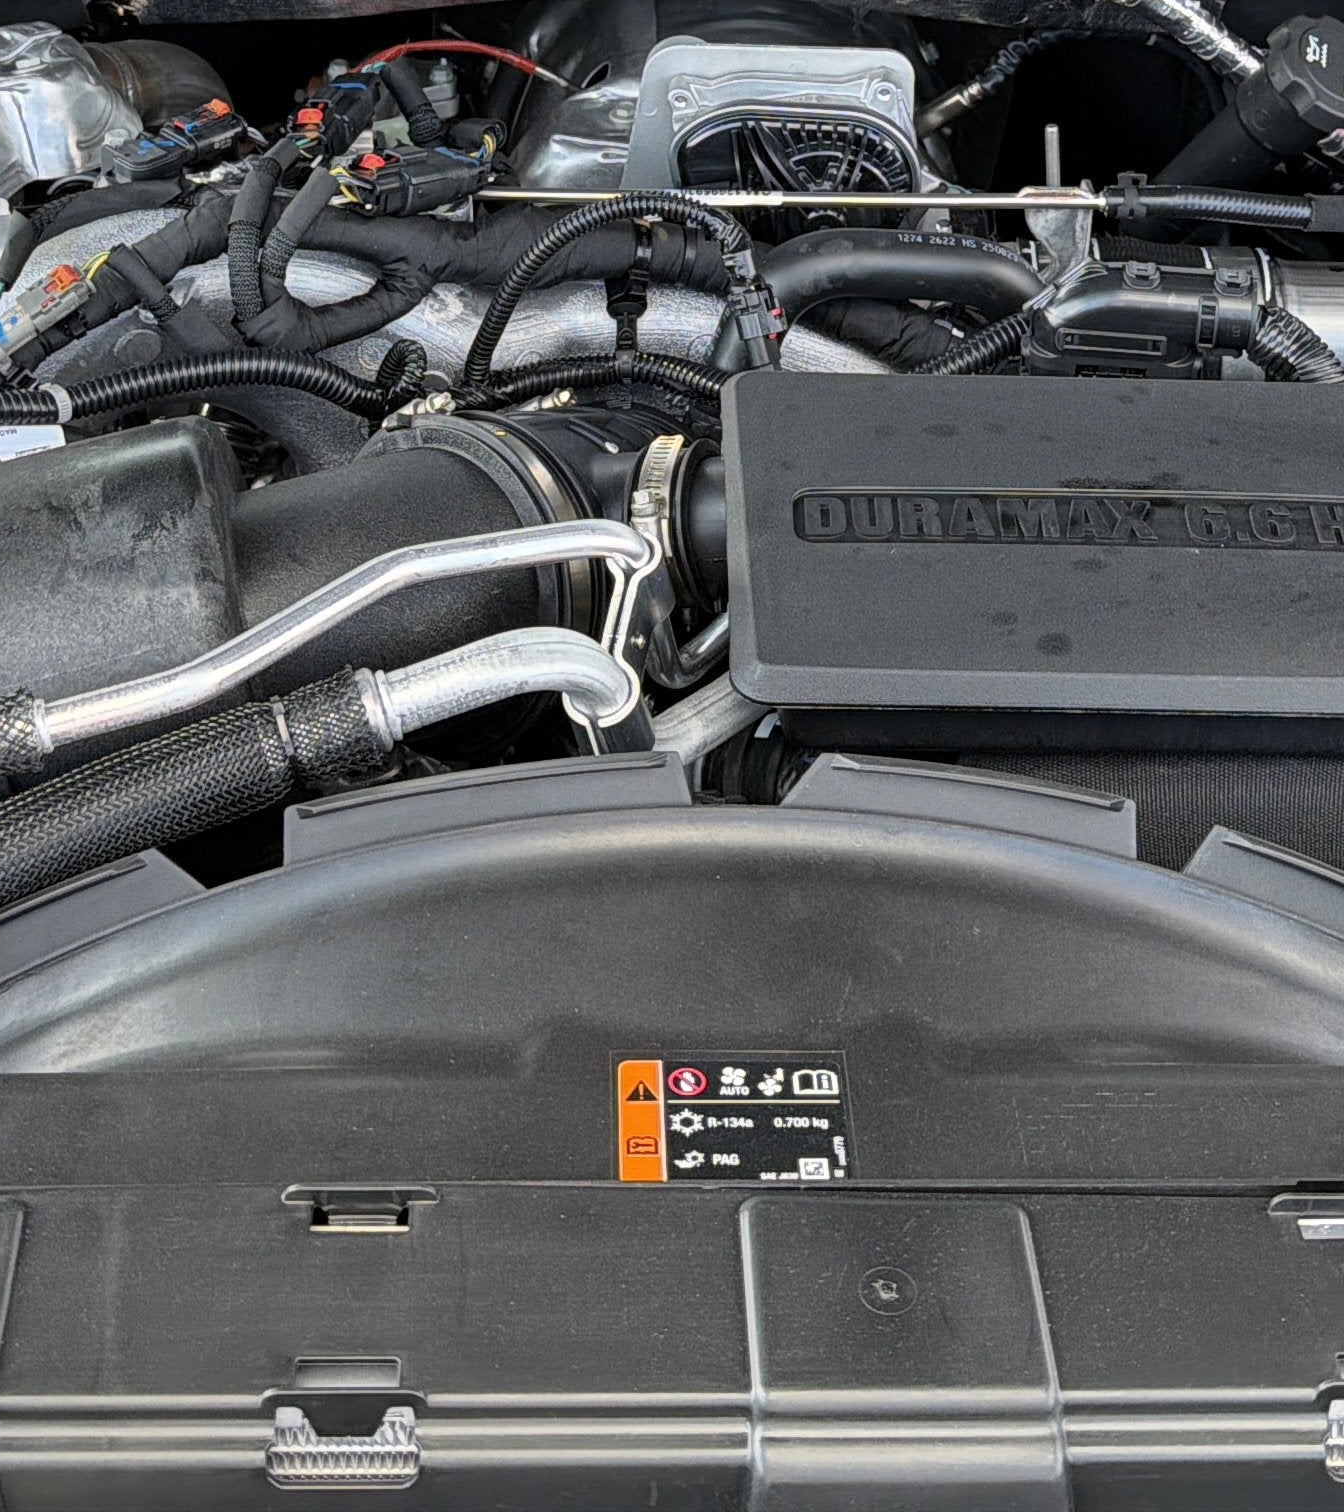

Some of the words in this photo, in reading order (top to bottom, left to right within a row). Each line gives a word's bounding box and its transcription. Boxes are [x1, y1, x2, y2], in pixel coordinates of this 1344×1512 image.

[897, 233, 923, 243] 1274
[929, 235, 956, 246] 2622
[961, 238, 977, 249] HS
[803, 495, 1158, 542] DURAMAX
[1183, 502, 1297, 544] 6.6
[719, 1086, 750, 1096] AUTO
[707, 1117, 754, 1128] R-134a
[773, 1117, 810, 1128] 0.700
[812, 1117, 829, 1130] kg
[712, 1153, 740, 1166] PAG
